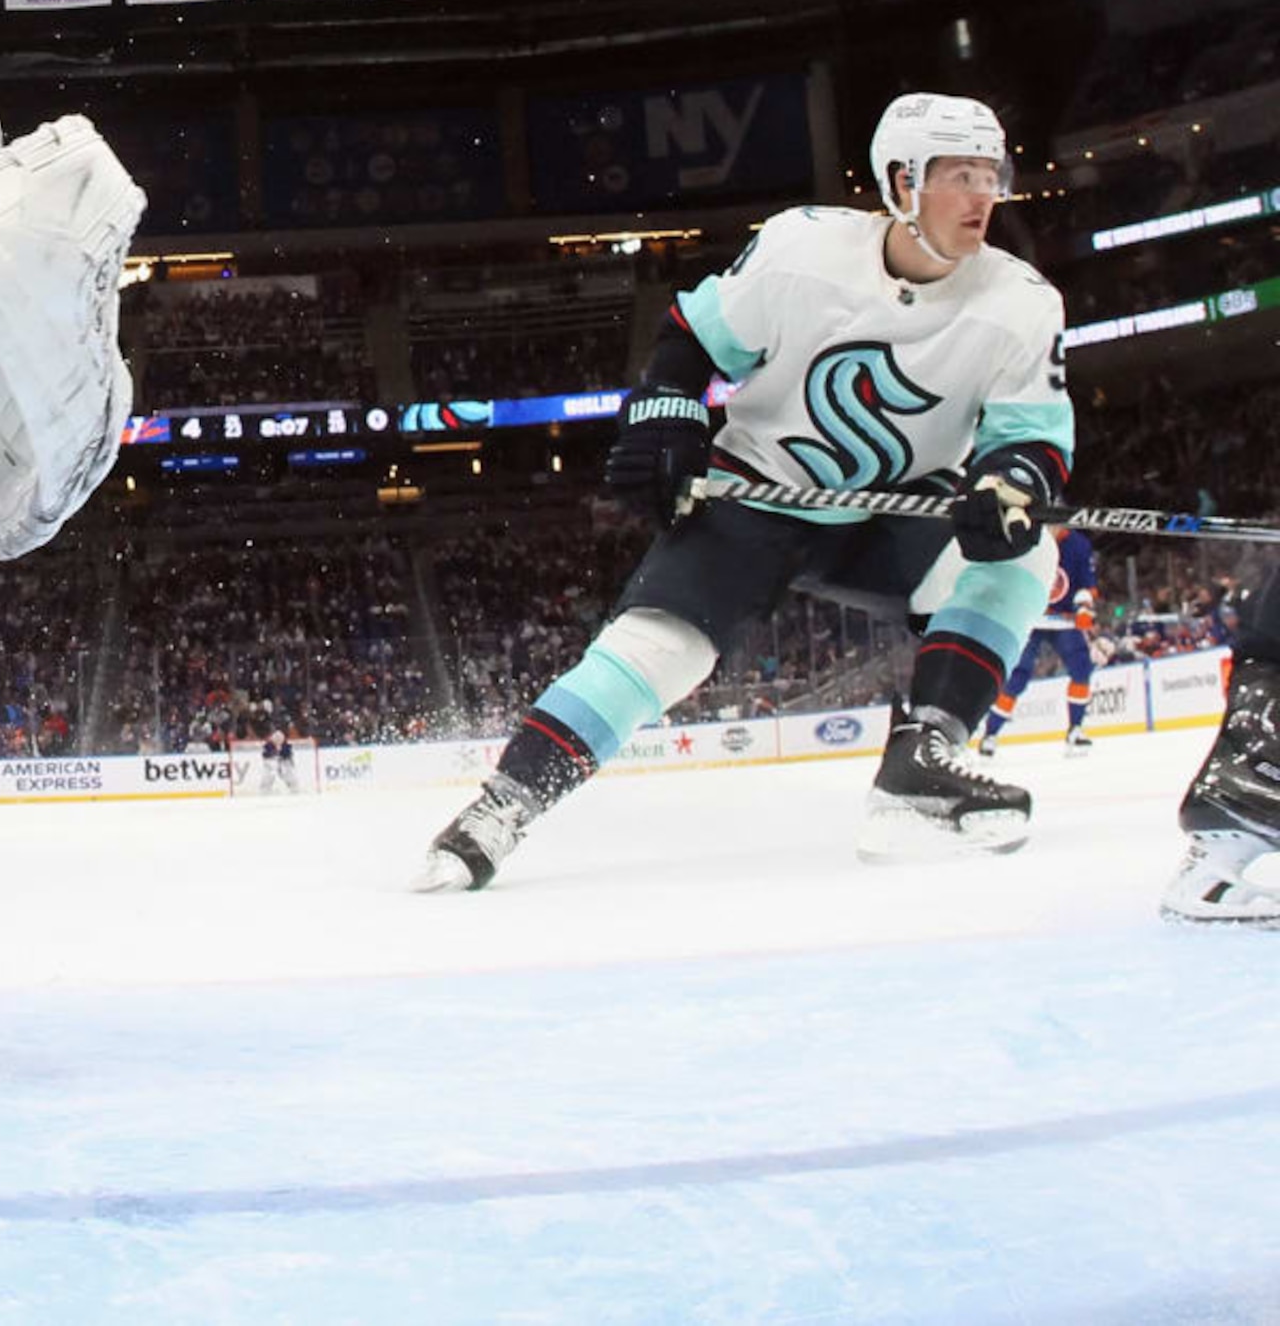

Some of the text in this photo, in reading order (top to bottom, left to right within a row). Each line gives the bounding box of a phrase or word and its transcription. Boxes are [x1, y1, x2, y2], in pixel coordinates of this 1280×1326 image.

[181, 417, 202, 439] 4
[259, 416, 309, 438] 8:07
[1068, 506, 1166, 532] ALPHA
[1, 761, 101, 776] AMERICAN
[144, 758, 250, 786] betway
[16, 776, 103, 792] EXPRESS
